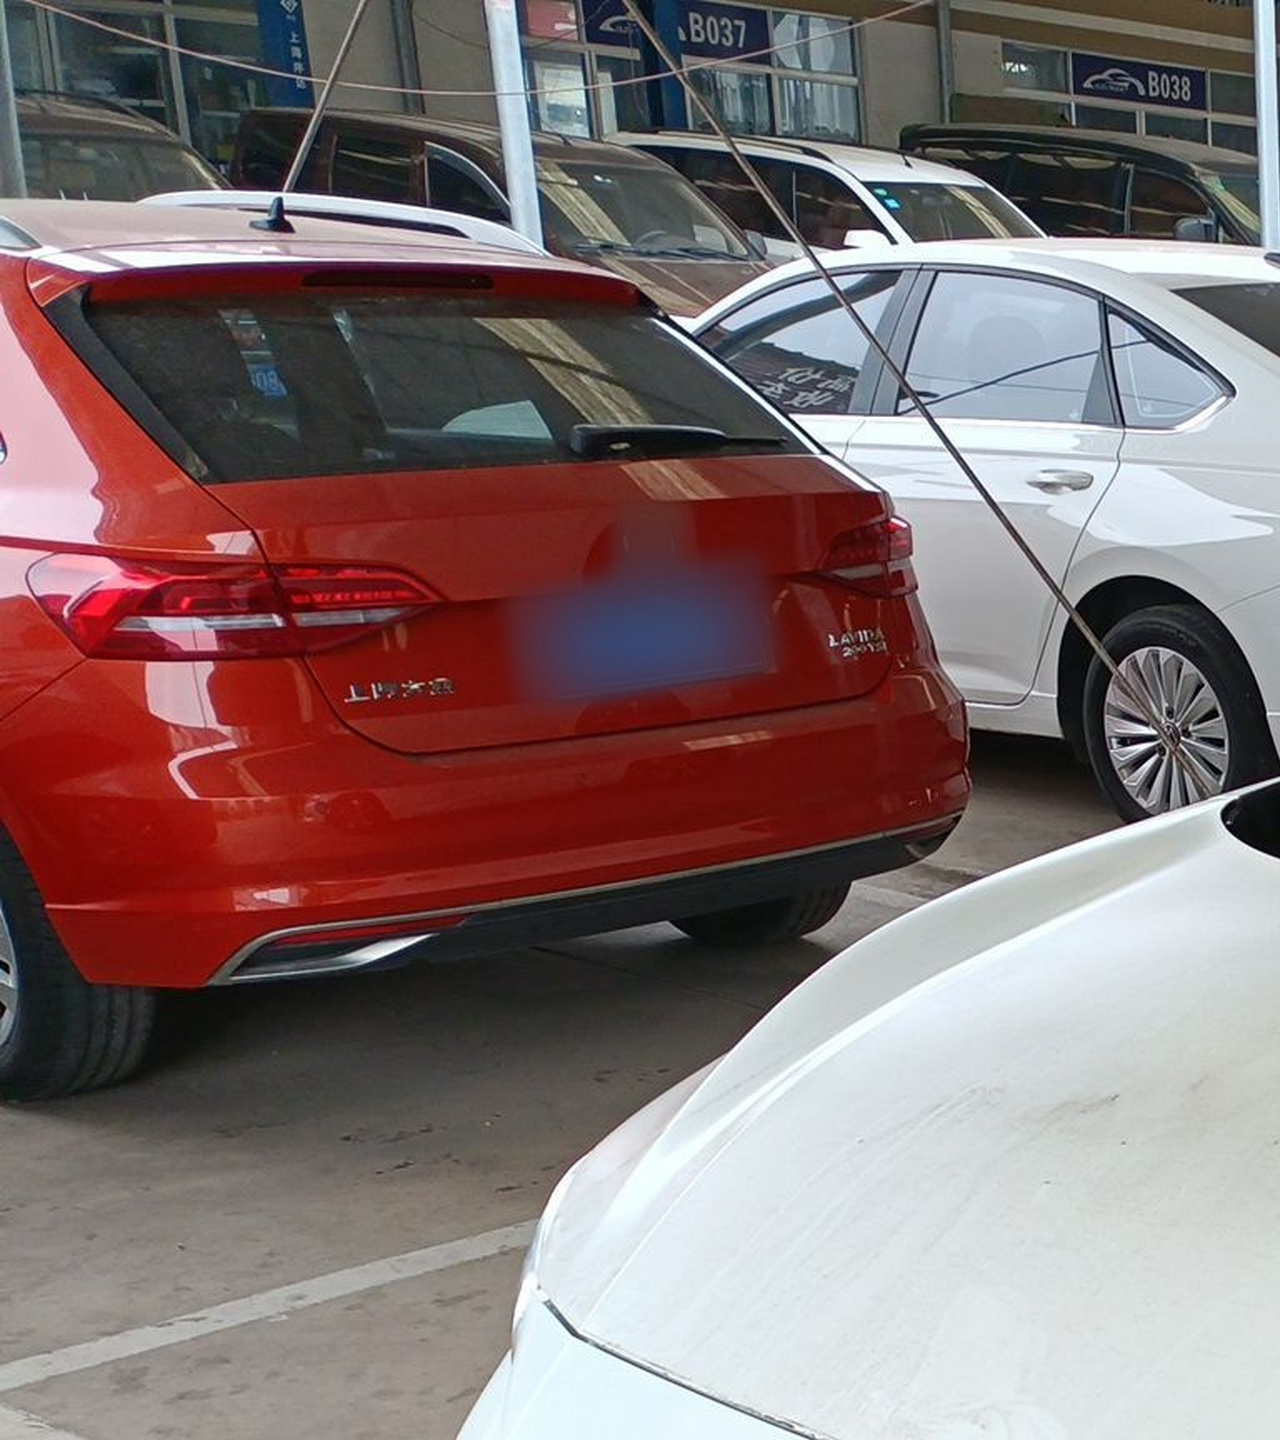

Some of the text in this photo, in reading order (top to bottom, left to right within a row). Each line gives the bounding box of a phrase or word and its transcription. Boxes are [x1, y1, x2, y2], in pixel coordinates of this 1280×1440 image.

[688, 12, 746, 48] B037
[1147, 70, 1191, 101] B038
[828, 628, 885, 648] LAVIDA
